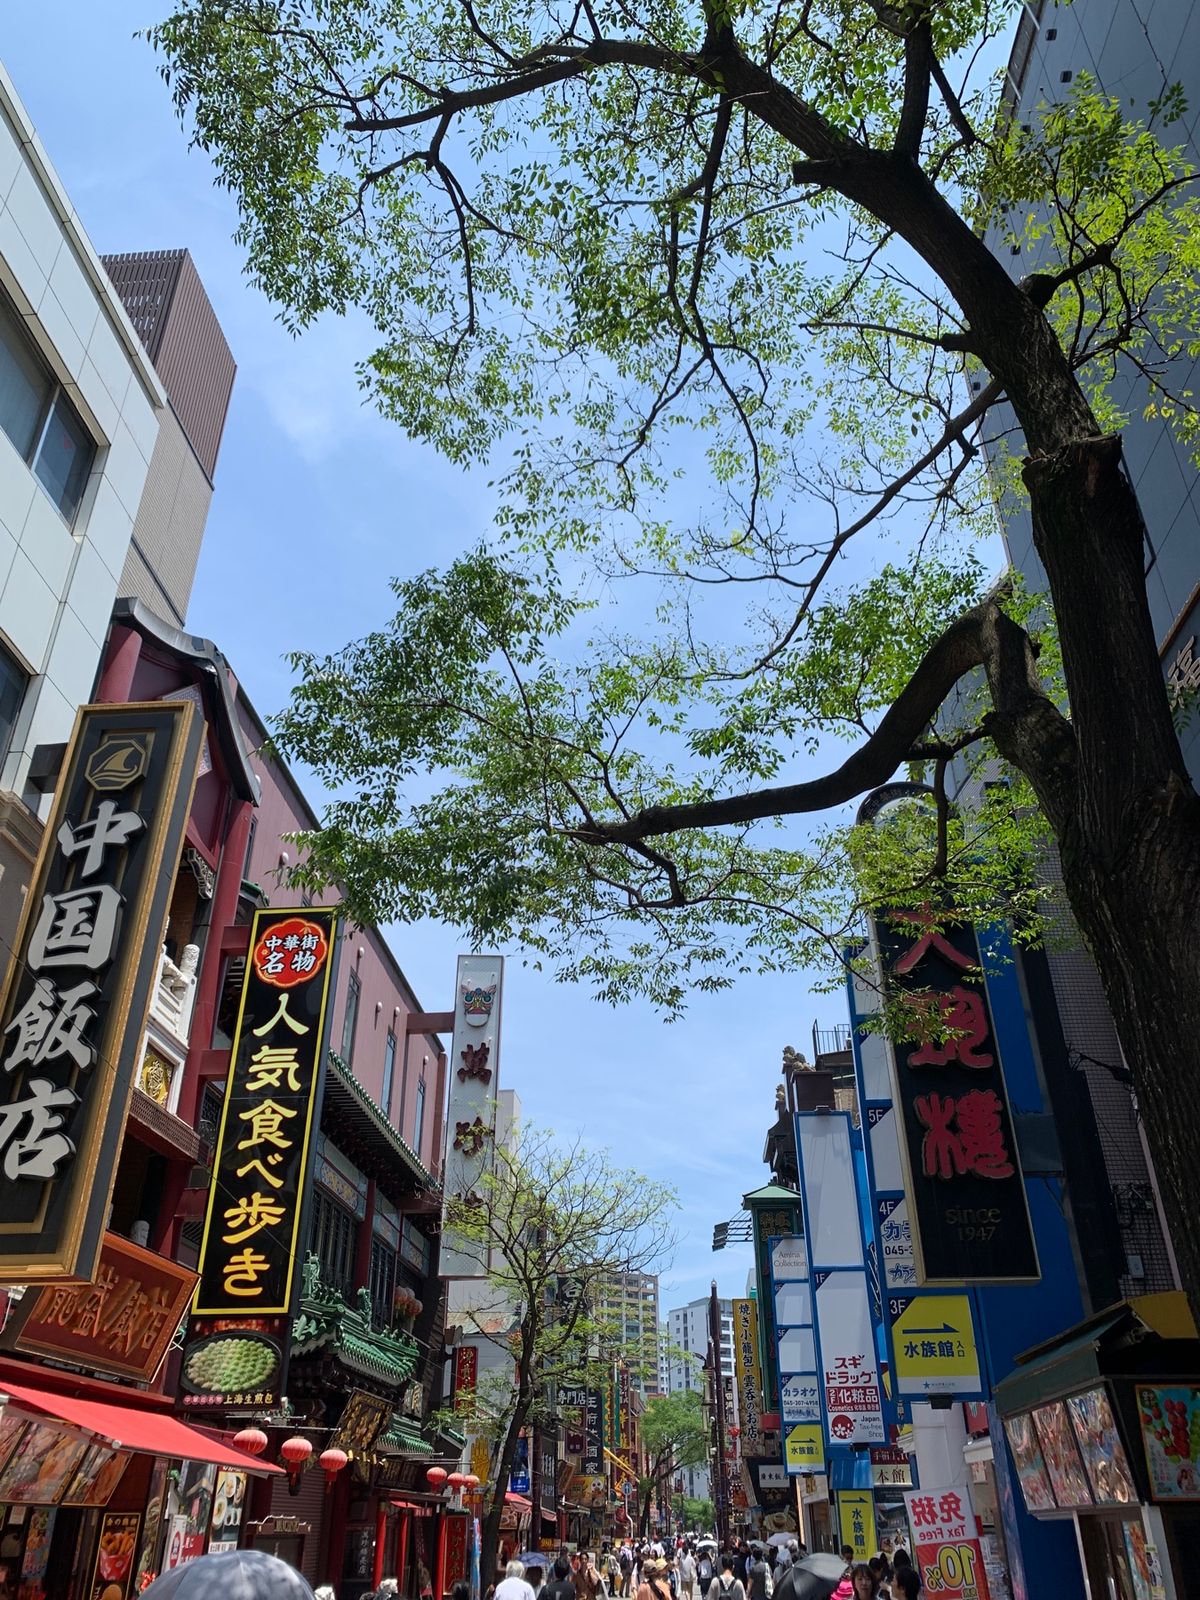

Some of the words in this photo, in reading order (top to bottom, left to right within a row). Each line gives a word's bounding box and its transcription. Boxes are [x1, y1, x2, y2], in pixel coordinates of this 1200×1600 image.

[265, 935, 320, 951] 中華街
[260, 950, 317, 973] 名物
[0, 799, 147, 1181] 中国飯店
[869, 1109, 886, 1124] 5F
[222, 993, 310, 1297] 人気食べ歩き
[879, 1201, 895, 1215] 4F
[945, 1205, 1001, 1224] since
[956, 1225, 996, 1243] 1947
[815, 1273, 825, 1284] 1F
[889, 1299, 906, 1315] 3F
[903, 1340, 954, 1358] 水族館
[956, 1340, 965, 1357] 入口
[834, 1355, 865, 1369] スギ
[825, 1371, 877, 1385] ドラッグ
[223, 1392, 274, 1405] 上海生煎包
[557, 1389, 586, 1405] 専門店
[783, 1387, 817, 1397] カラオケ
[838, 1388, 878, 1403] 化粧品
[828, 1404, 854, 1412] Cosmetics
[860, 1415, 881, 1423] Japan.
[868, 1431, 883, 1439] Shop
[790, 1446, 814, 1455] 水族館
[851, 1507, 865, 1546] 水族館
